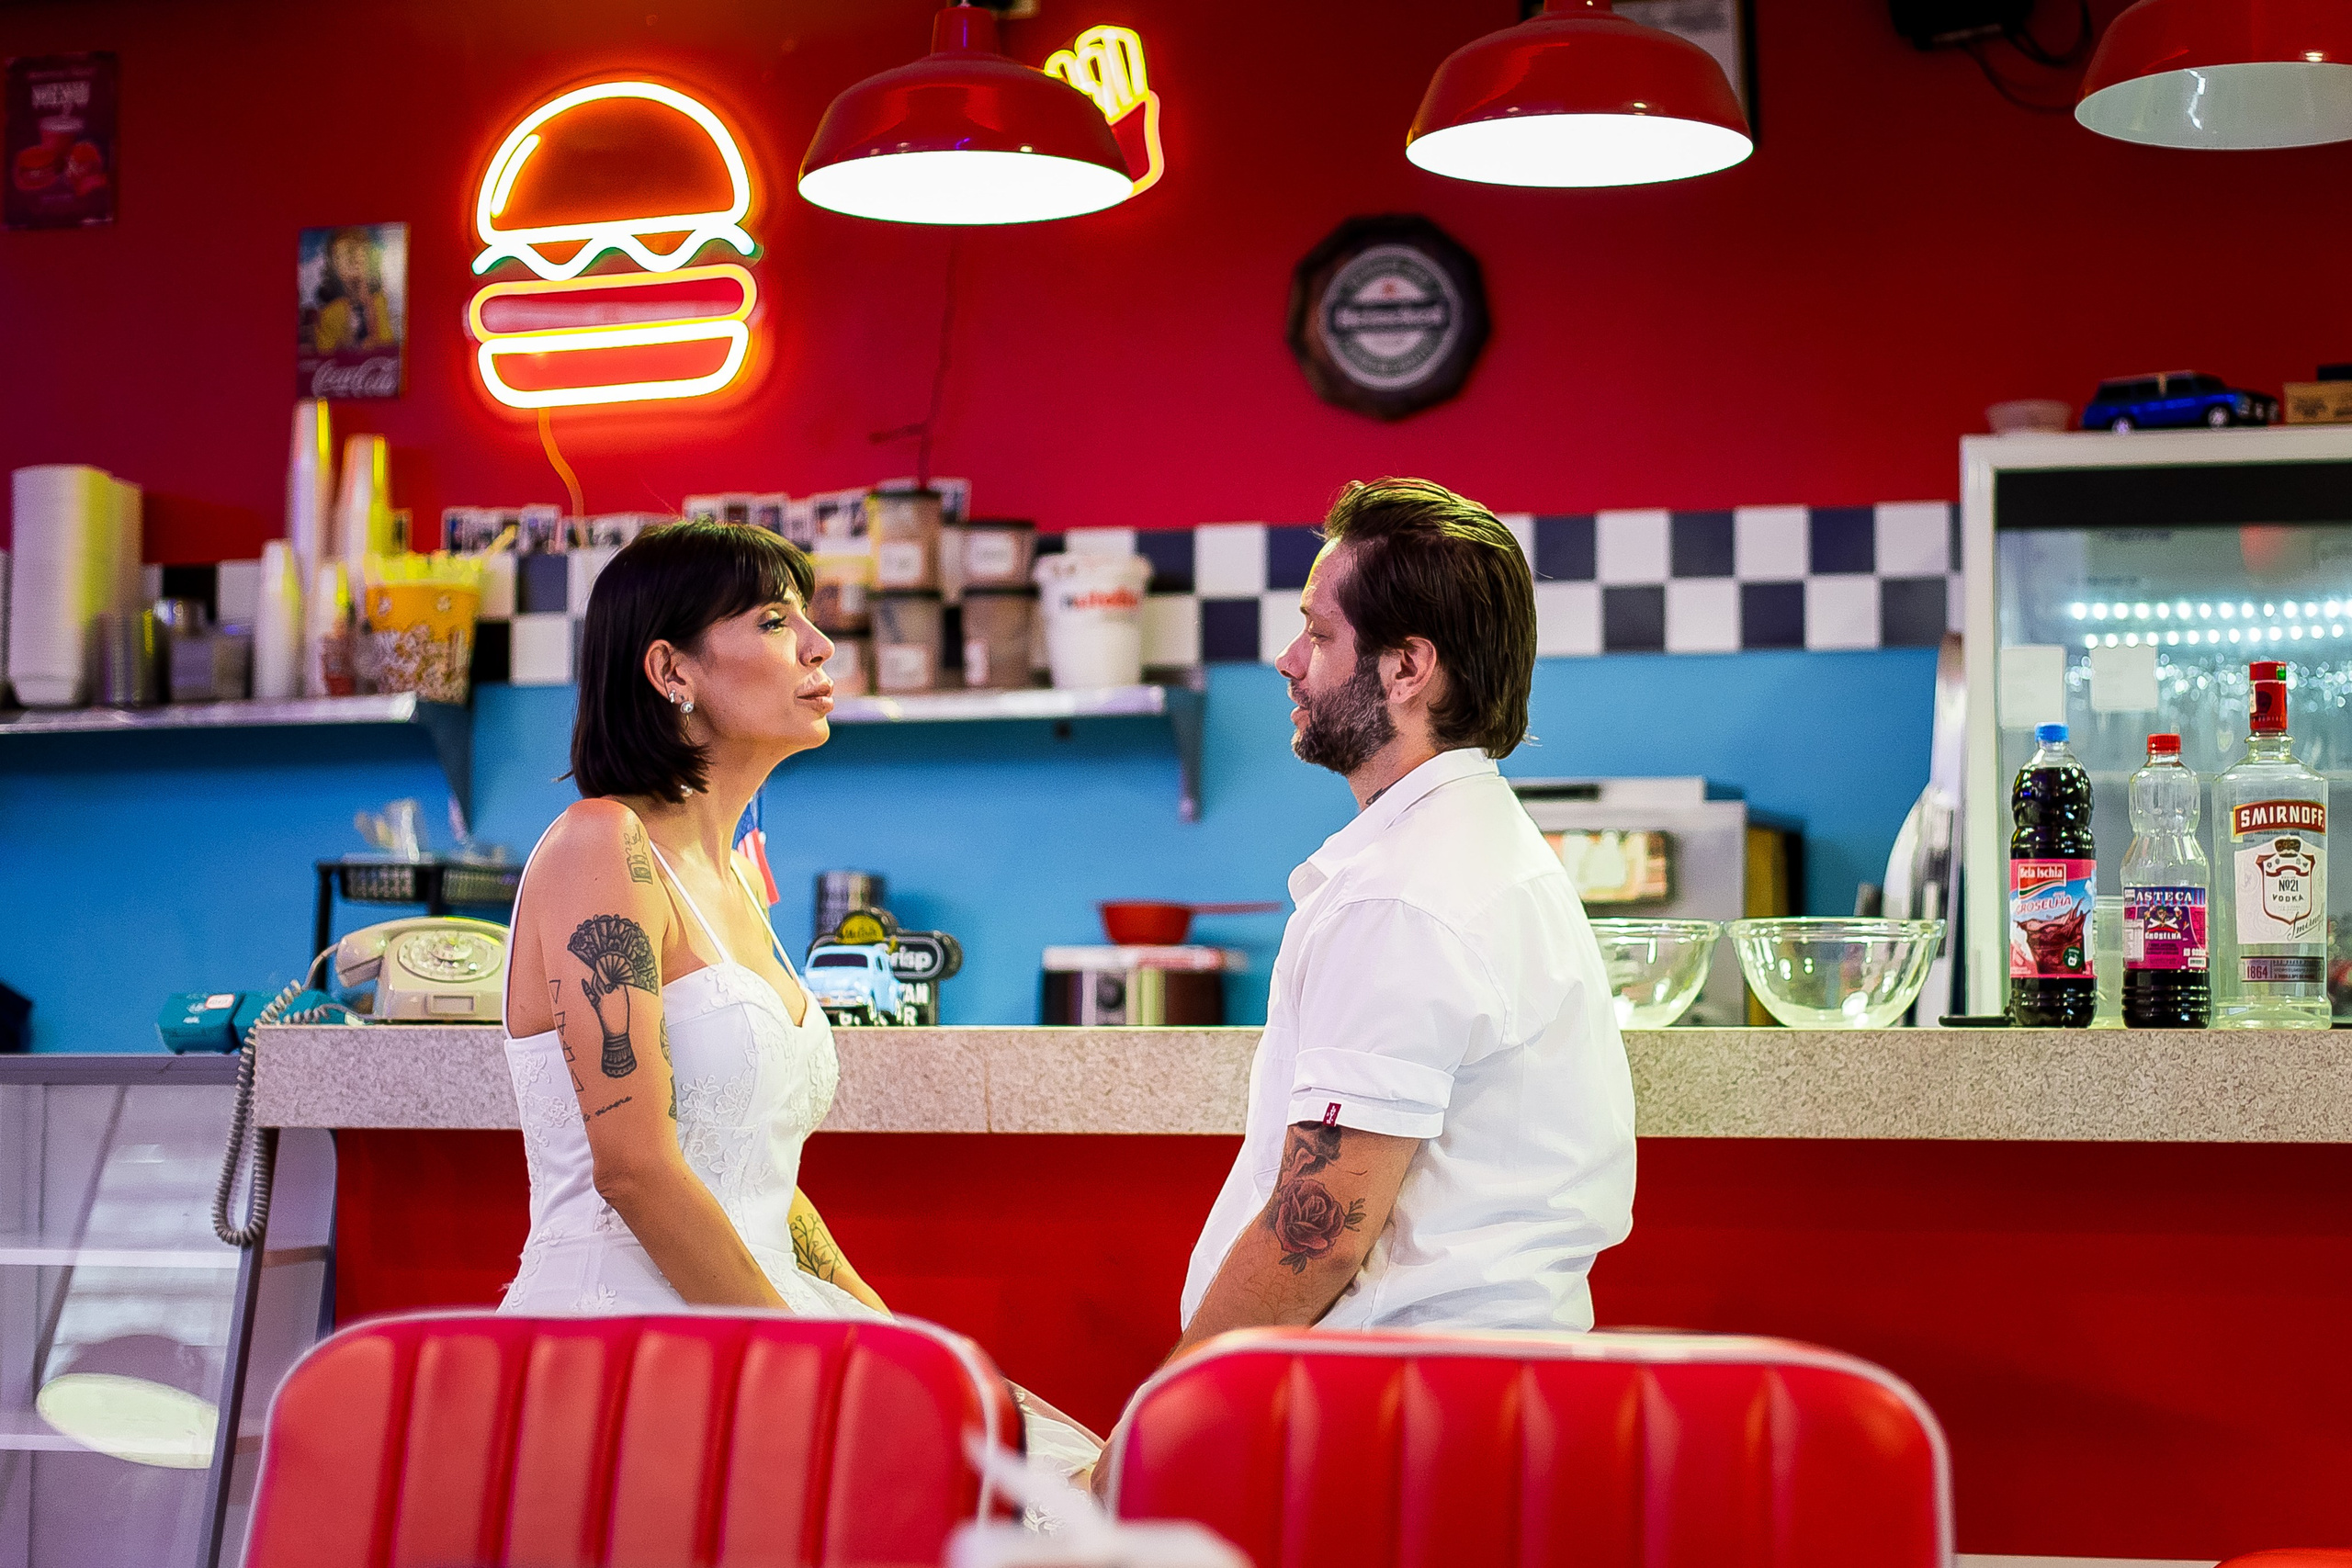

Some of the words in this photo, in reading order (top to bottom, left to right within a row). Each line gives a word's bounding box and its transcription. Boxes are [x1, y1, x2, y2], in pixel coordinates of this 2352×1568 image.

[2240, 806, 2324, 829] SMIRNOFF
[2136, 891, 2192, 902] ASTECA
[2272, 894, 2304, 903] VODKA
[2246, 965, 2268, 979] 1864
